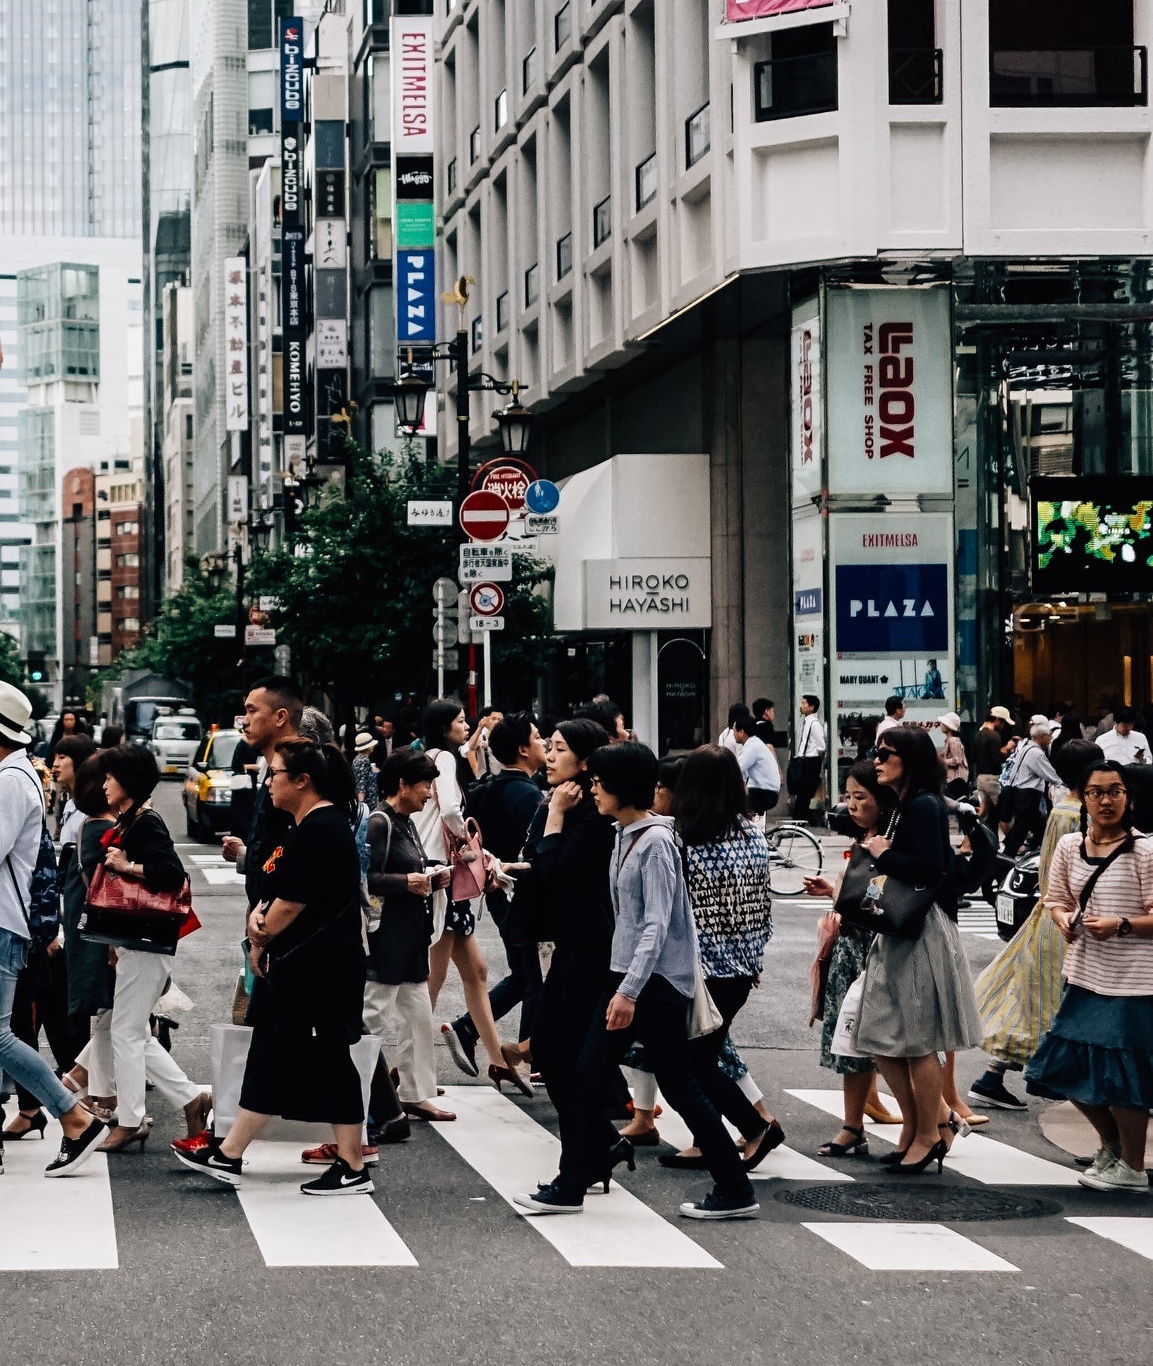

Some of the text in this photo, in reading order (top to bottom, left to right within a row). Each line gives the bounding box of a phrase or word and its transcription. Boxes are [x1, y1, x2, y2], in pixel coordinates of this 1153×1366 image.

[284, 43, 300, 110] bizcube
[402, 33, 427, 137] EXITMELSA
[284, 150, 297, 211] bizcube
[407, 256, 425, 335] PLAZA
[289, 341, 301, 413] KOMEHYO
[863, 322, 874, 460] TAX FREE SHOP
[487, 482, 525, 499] 消火栓
[862, 533, 919, 547] EXITMELSA
[463, 547, 509, 556] 自転車を除く
[610, 574, 689, 589] HIROKO
[610, 597, 689, 613] HAYASHI
[850, 599, 935, 618] PLAZA
[839, 675, 879, 685] MARY QUANT
